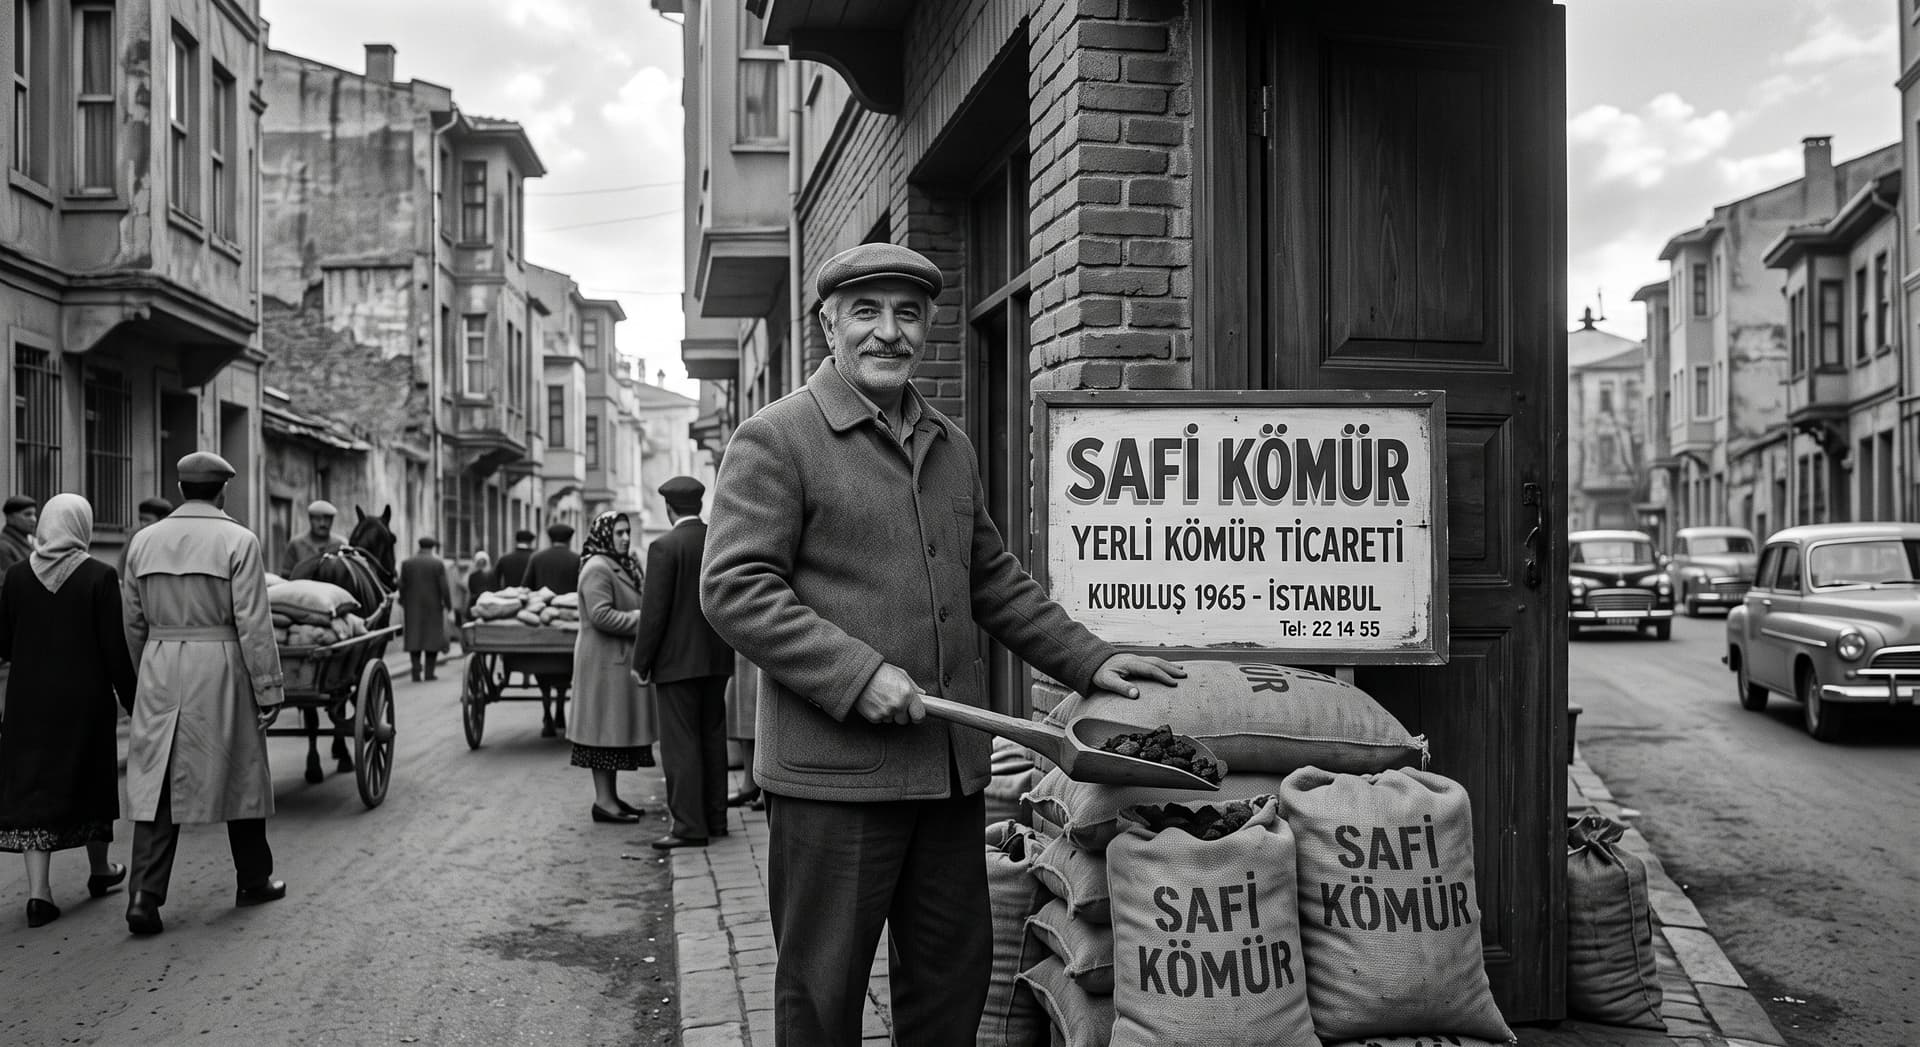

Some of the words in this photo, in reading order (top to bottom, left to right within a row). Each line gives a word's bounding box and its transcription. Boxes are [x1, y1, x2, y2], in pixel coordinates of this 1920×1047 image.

[1065, 423, 1200, 506] SAFİ
[1218, 423, 1411, 507] KÖMÜR
[1070, 517, 1152, 561] YERLİ
[1164, 517, 1266, 562] KÖMÜR
[1275, 518, 1404, 563] TİCARETİ
[1088, 583, 1186, 615] KURULUŞ
[1194, 583, 1246, 611] 1965
[1269, 577, 1382, 612] İSTANBUL
[1279, 620, 1307, 637] Tel:
[1312, 620, 1332, 637] 22
[1336, 620, 1355, 637] 14
[1359, 620, 1380, 638] 55
[1335, 815, 1440, 871] SAFİ
[1153, 871, 1260, 934] SAFİ
[1320, 875, 1473, 933] KÖMÜR
[1138, 936, 1295, 998] KÖMÜR
